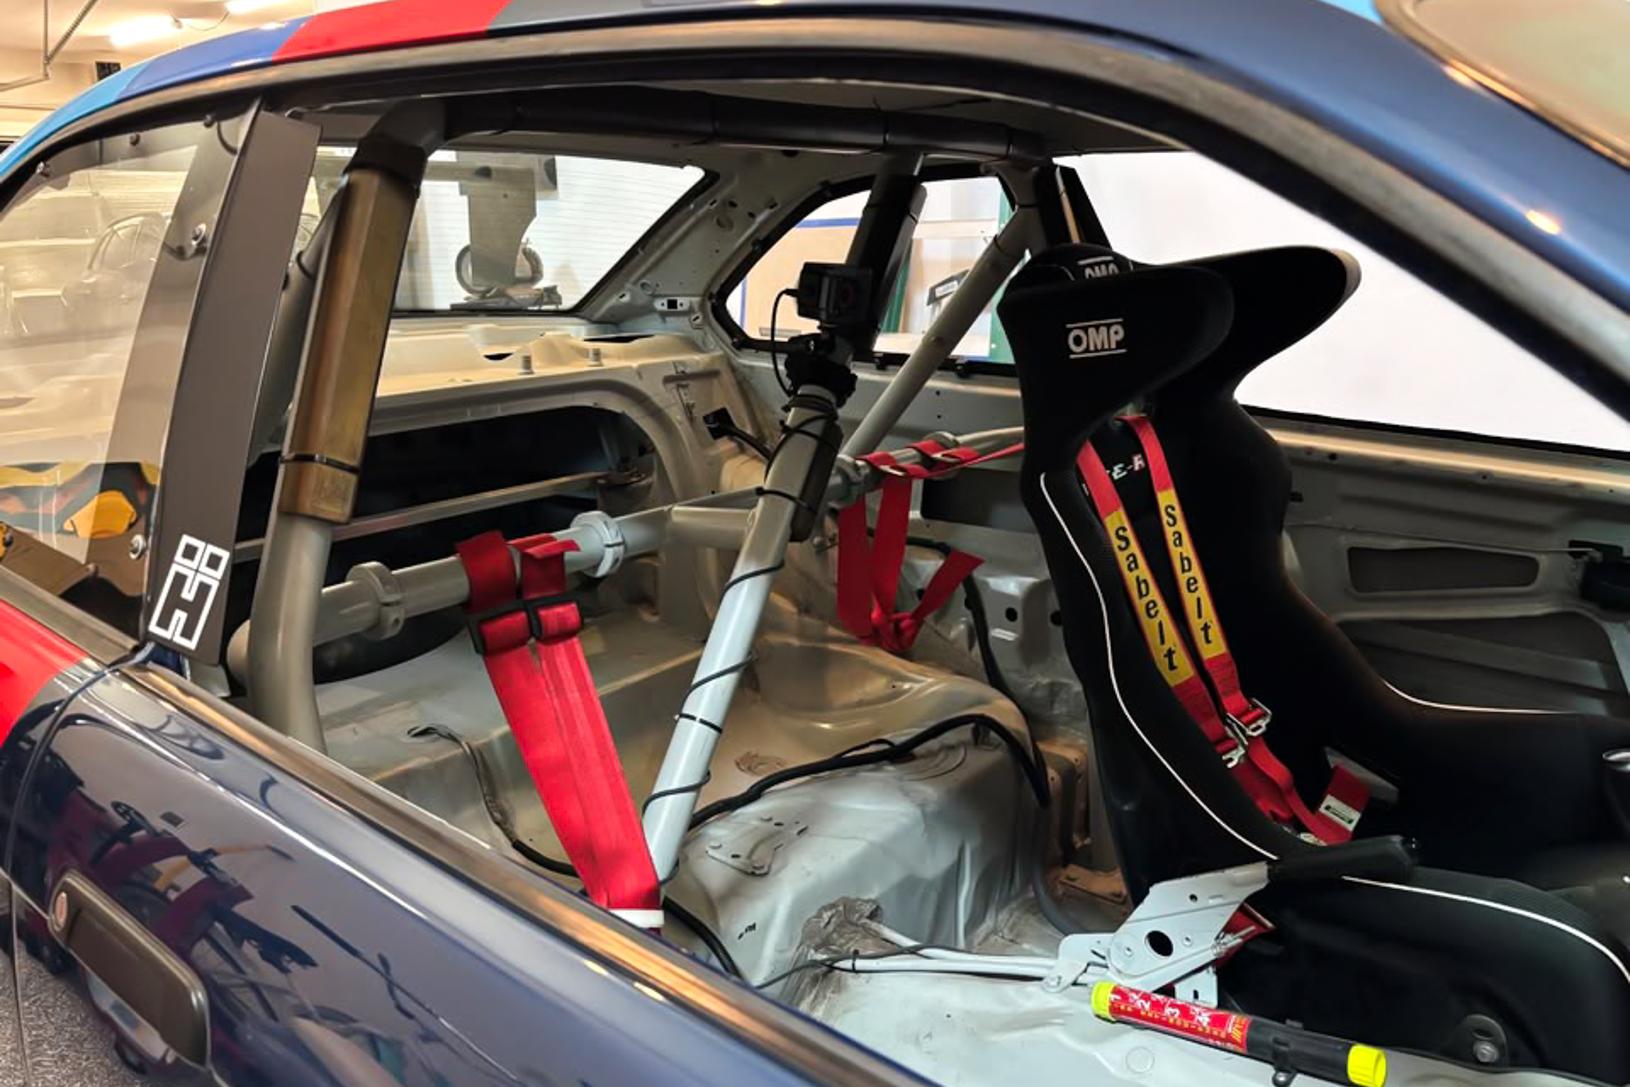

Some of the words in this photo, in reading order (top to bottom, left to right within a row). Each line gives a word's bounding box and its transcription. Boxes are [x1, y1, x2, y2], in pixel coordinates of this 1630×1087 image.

[1067, 324, 1125, 353] OMP
[1114, 526, 1178, 672] Sabelt
[1164, 504, 1213, 645] Sabelt
